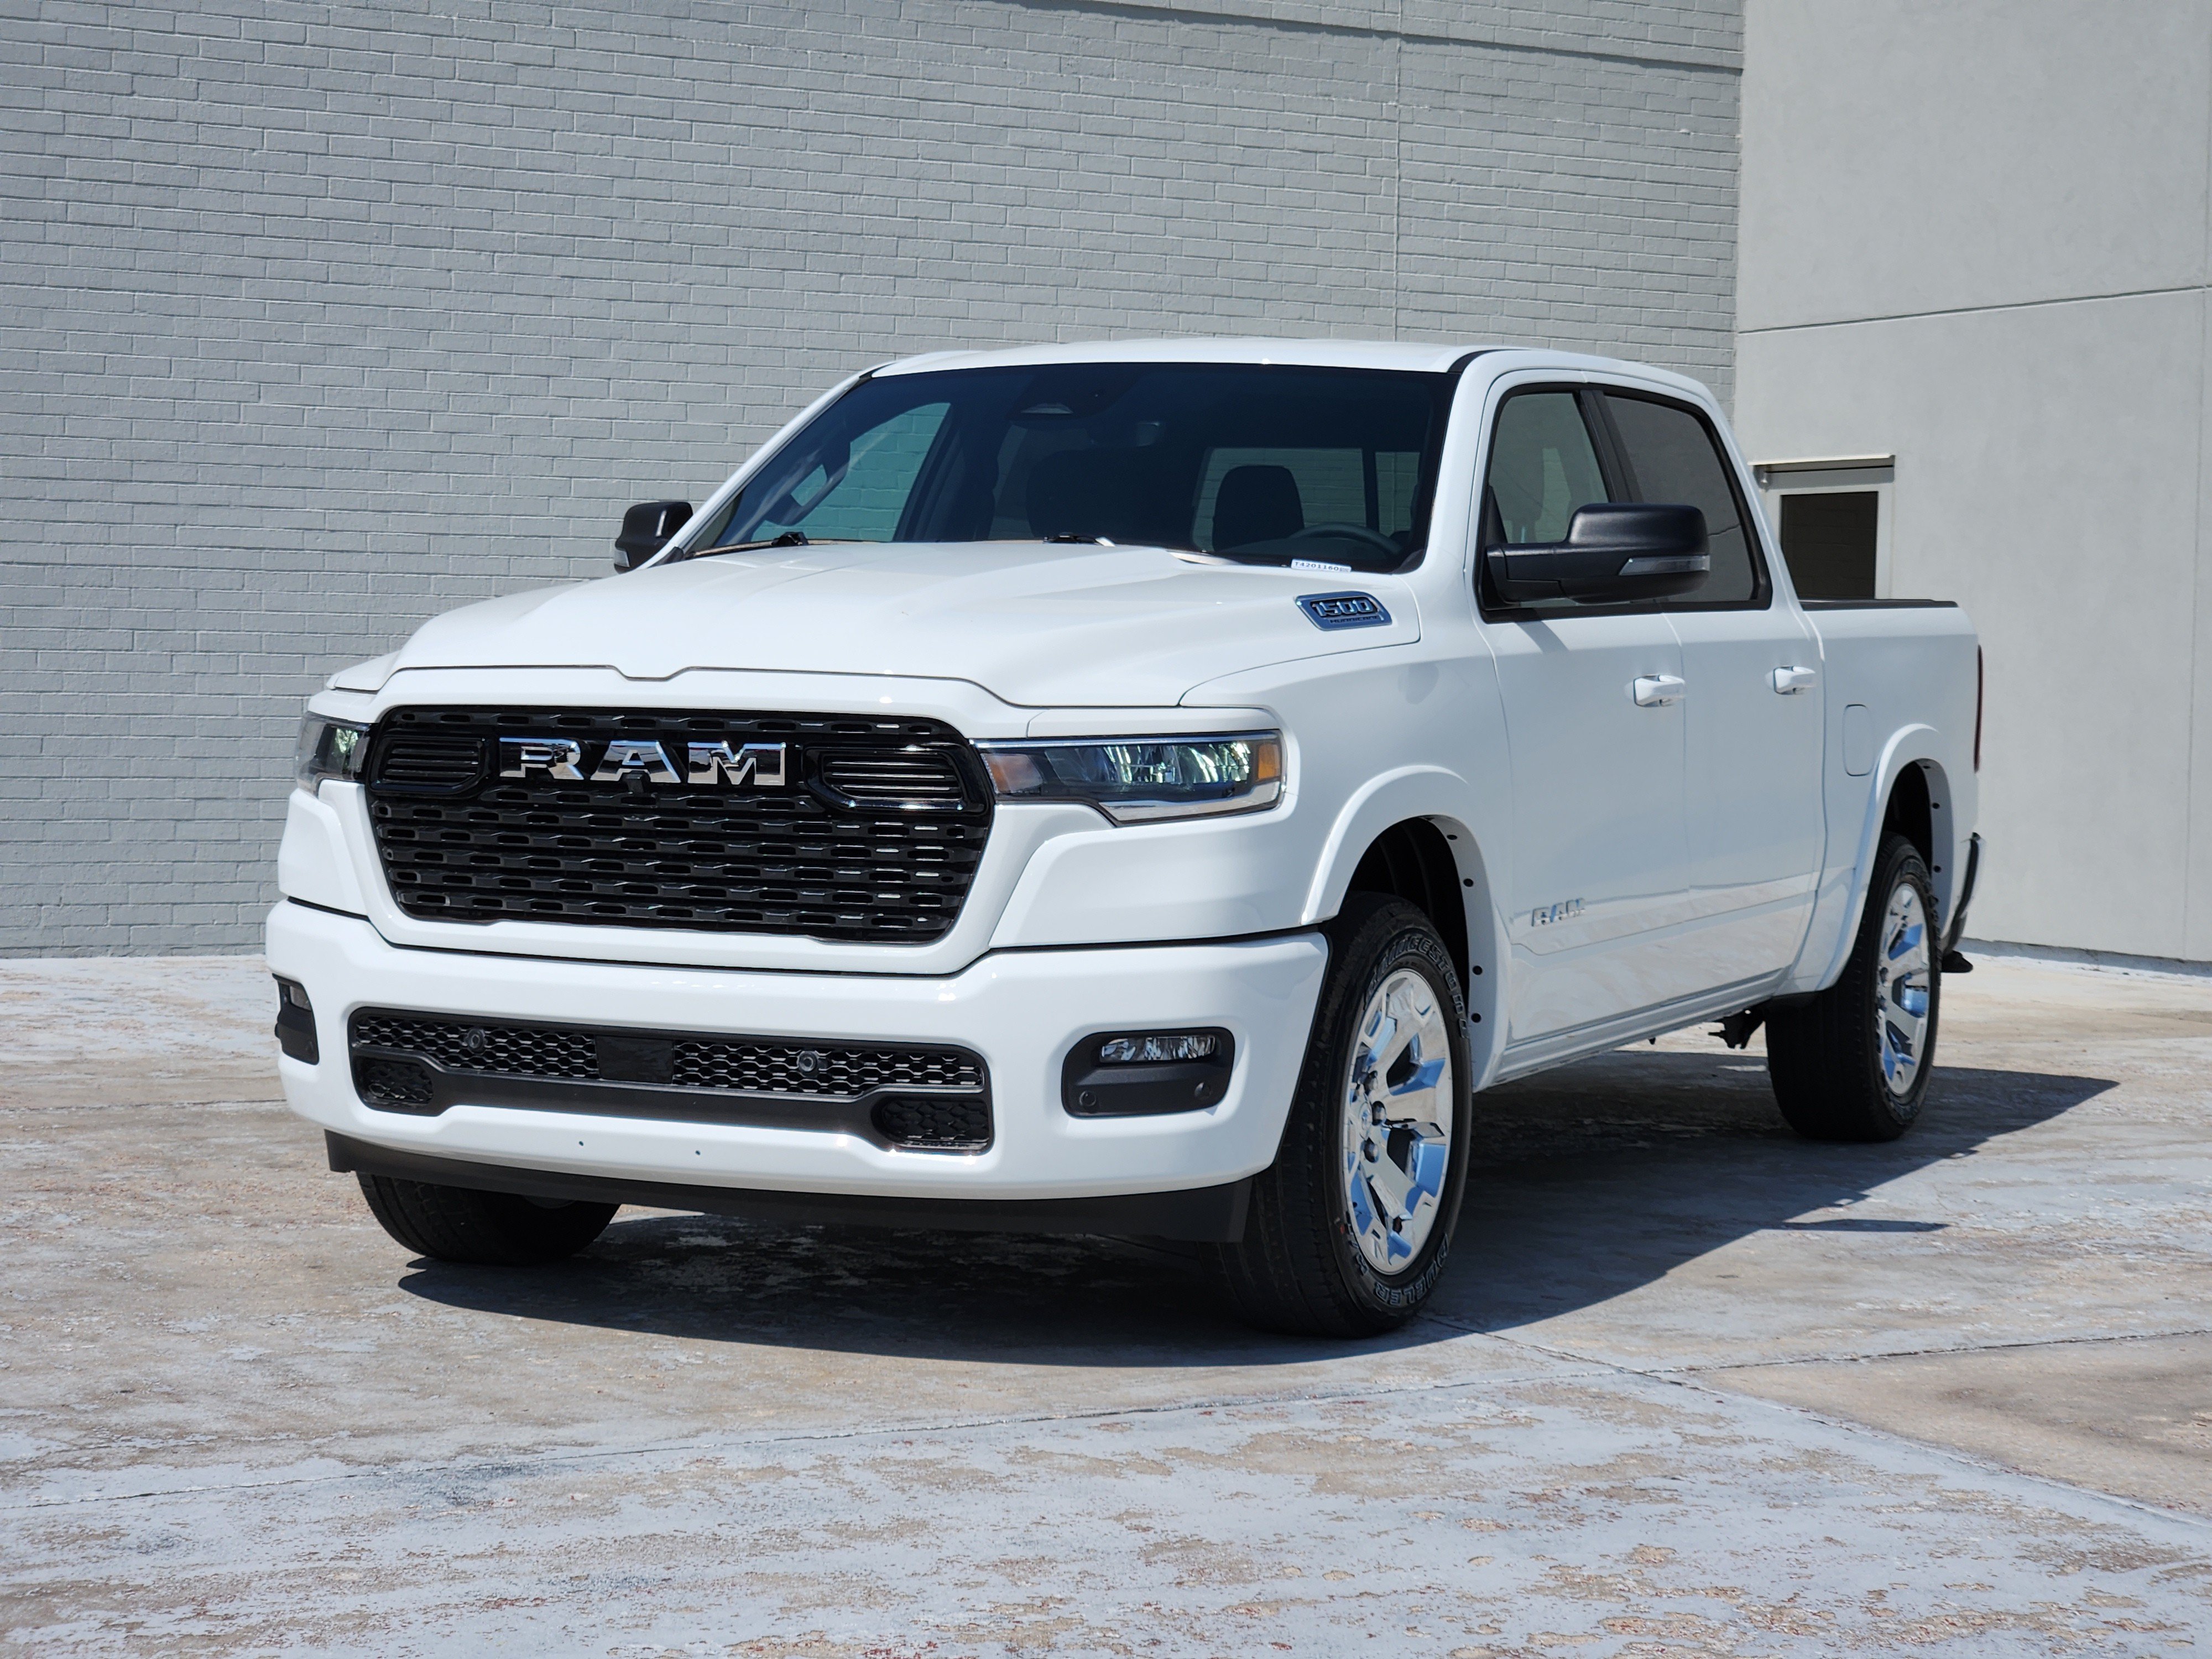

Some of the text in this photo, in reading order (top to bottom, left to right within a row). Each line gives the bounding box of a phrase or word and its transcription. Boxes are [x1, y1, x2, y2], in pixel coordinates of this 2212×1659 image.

[1295, 561, 1339, 571] T4201160
[1312, 599, 1374, 617] 1500
[499, 737, 786, 786] RAM
[1531, 897, 1586, 927] RAM
[1373, 1232, 1449, 1307] DUELER
